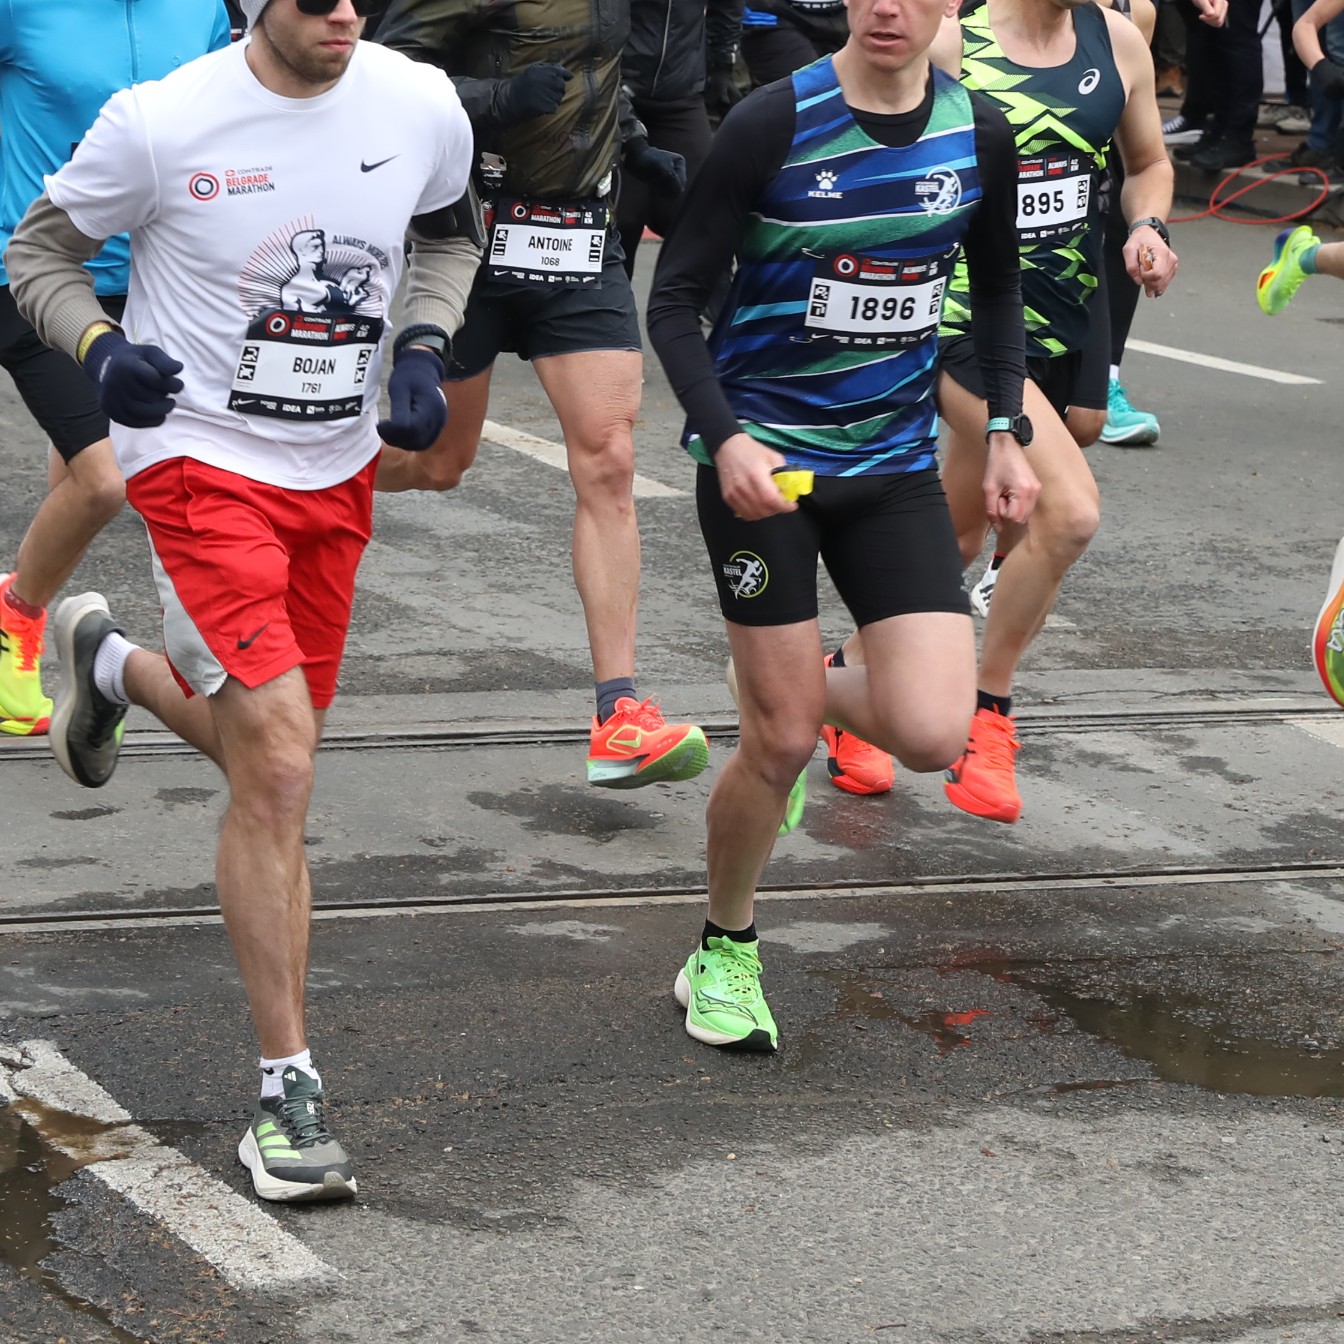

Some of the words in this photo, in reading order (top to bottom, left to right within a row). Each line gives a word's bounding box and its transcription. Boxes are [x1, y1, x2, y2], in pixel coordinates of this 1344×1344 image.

[225, 173, 270, 187] BELGRADE
[227, 182, 276, 197] MARATHON
[807, 190, 844, 199] KELME
[1022, 189, 1065, 217] 895
[530, 214, 562, 225] MARATHON
[527, 235, 574, 252] ANTOINE
[540, 256, 561, 267] 1068
[850, 295, 917, 321] 1896
[292, 356, 337, 375] BOJAN
[301, 382, 322, 394] 1761
